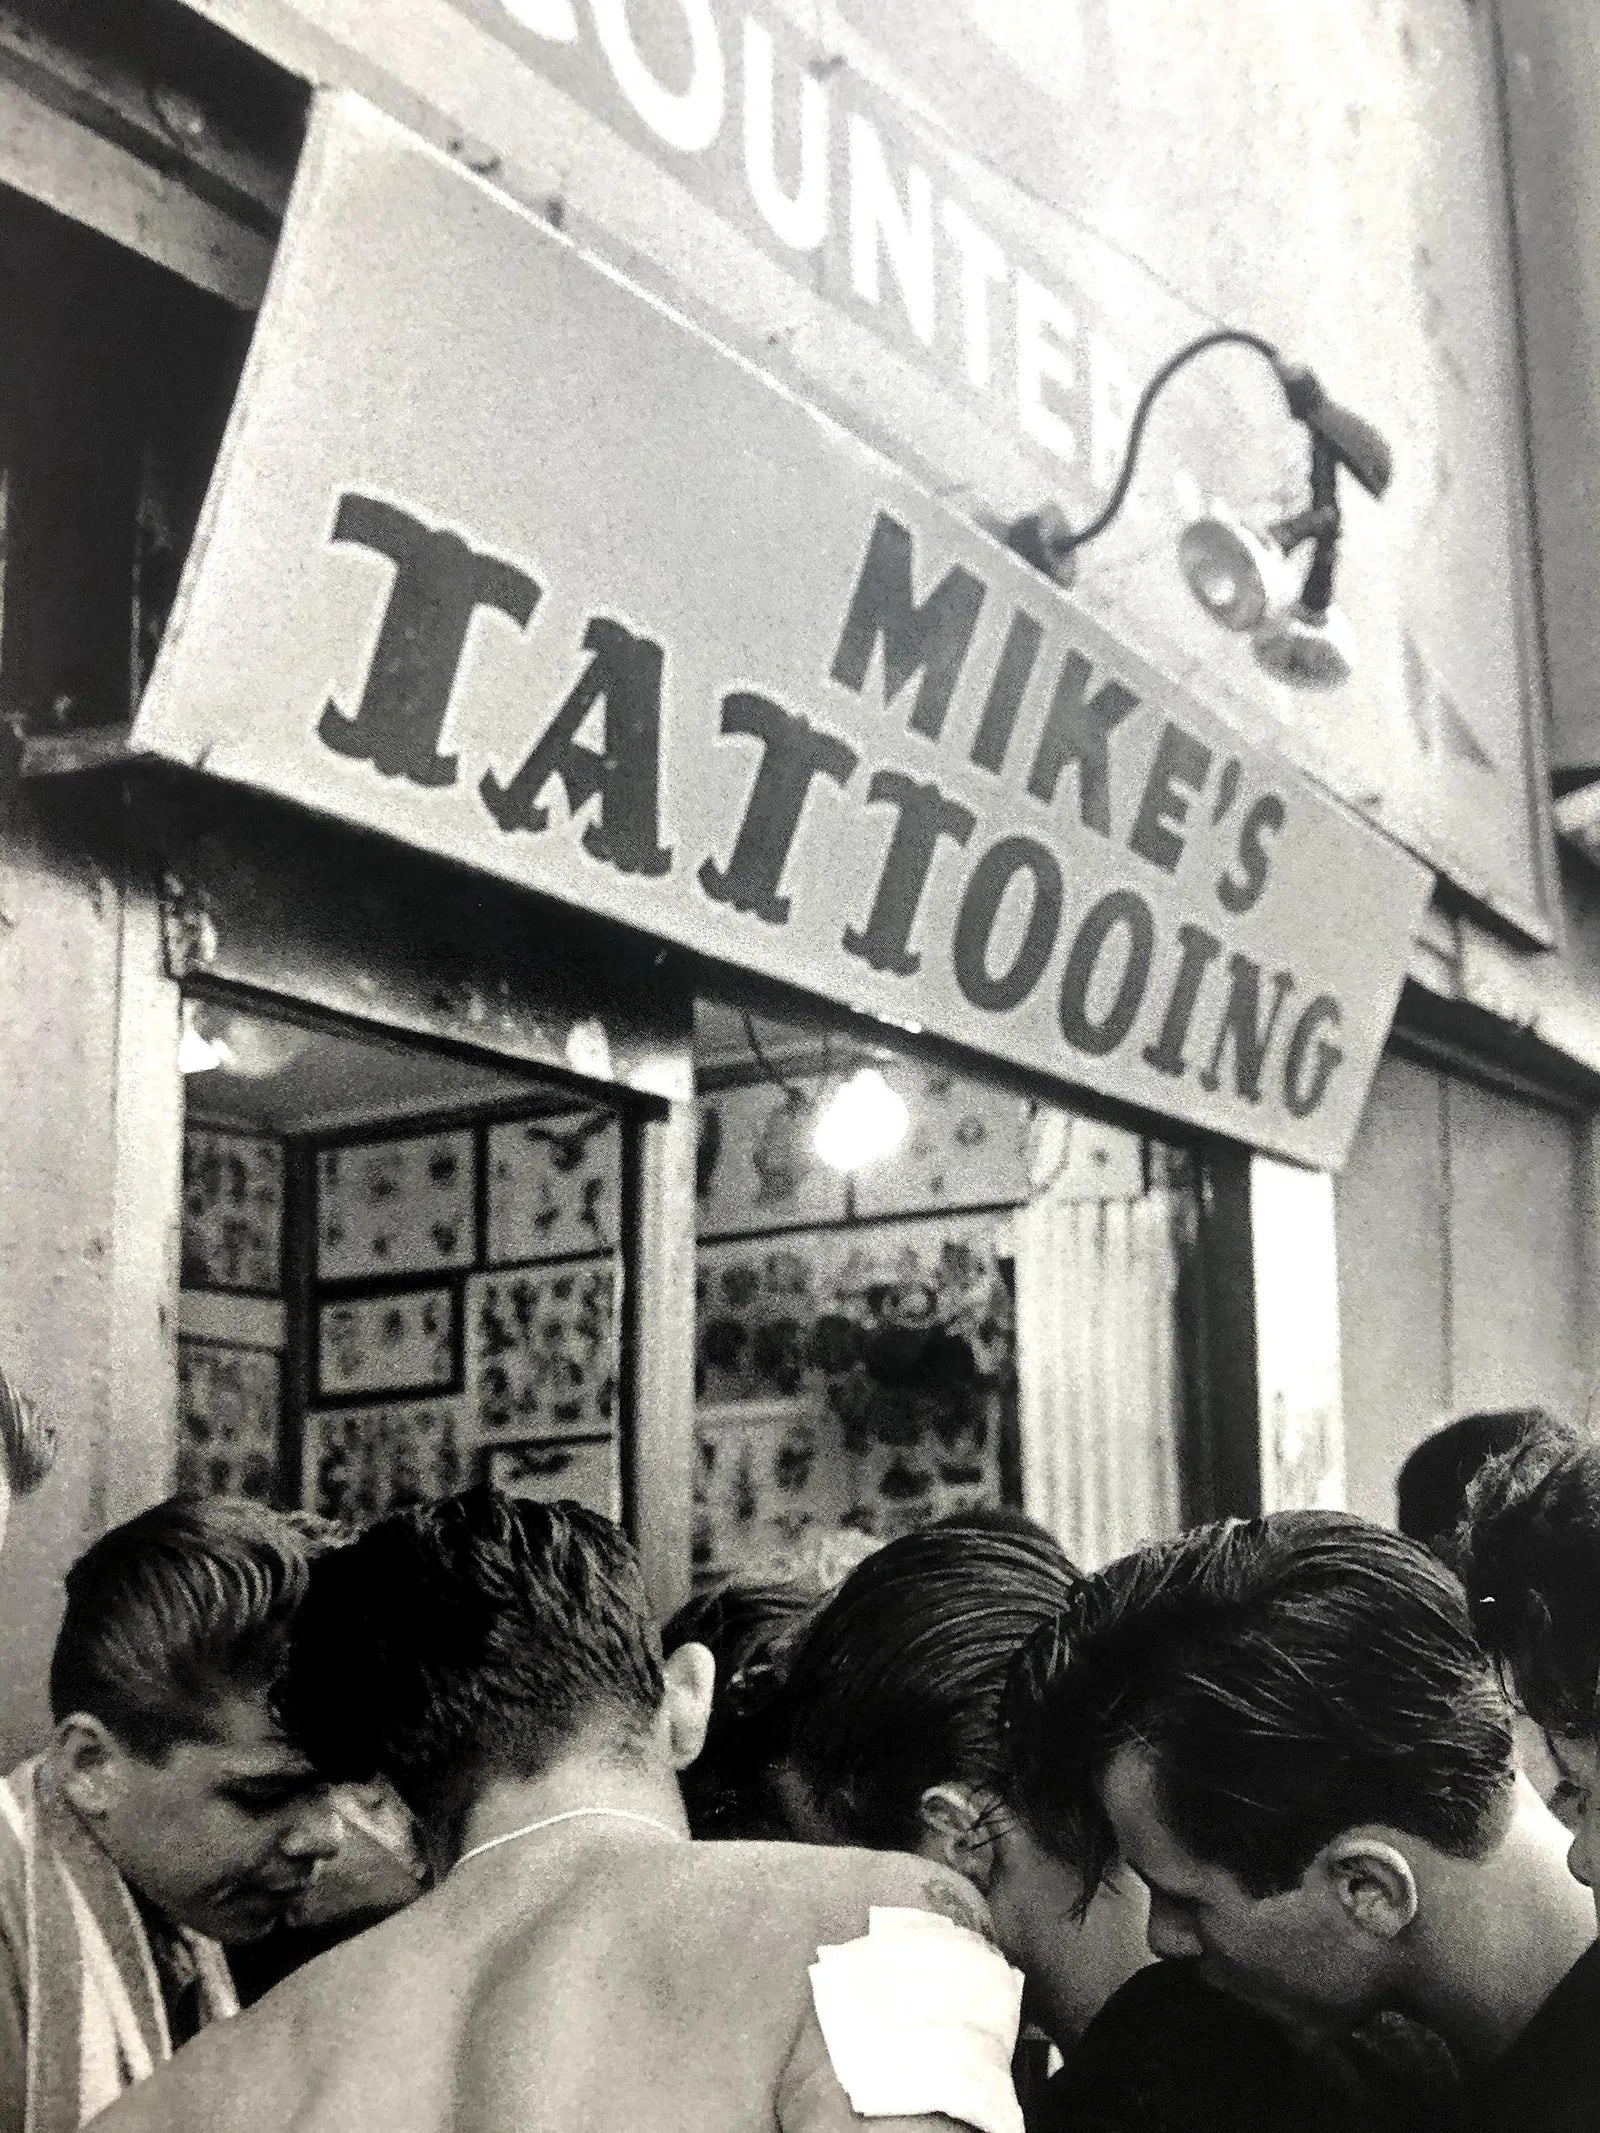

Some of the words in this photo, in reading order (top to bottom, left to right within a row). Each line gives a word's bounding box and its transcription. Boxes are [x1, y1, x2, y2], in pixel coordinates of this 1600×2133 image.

[498, 0, 1142, 500] OUNTER
[316, 492, 1343, 1118] TATTOOING
[829, 512, 1286, 912] MIKE'S
